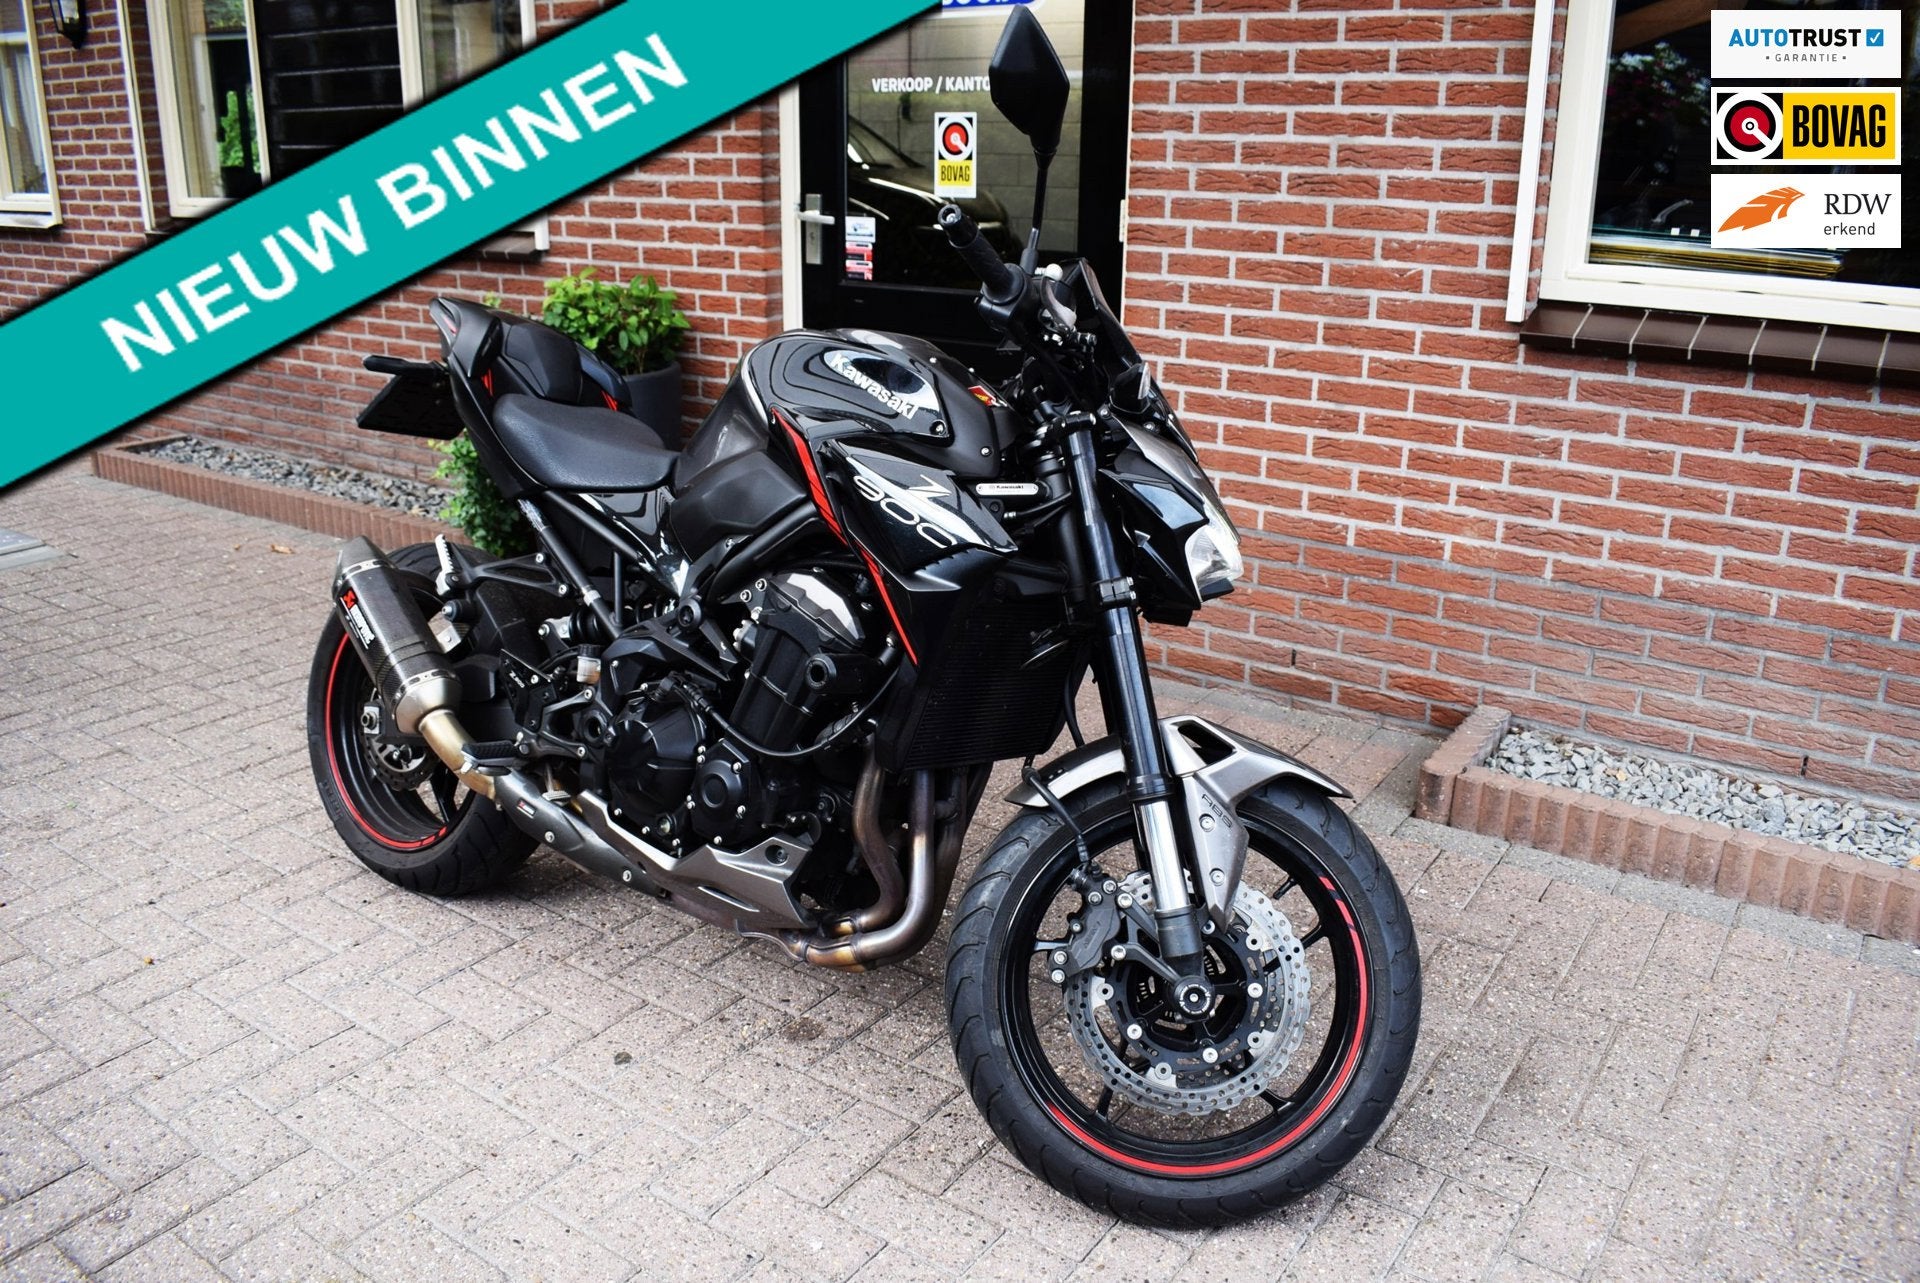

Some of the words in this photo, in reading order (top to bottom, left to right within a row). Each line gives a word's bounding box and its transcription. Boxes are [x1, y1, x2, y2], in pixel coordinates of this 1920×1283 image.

[872, 77, 933, 92] VERKOOP
[935, 76, 943, 94] /
[940, 164, 970, 182] BOVAG
[830, 352, 919, 421] Kawasaki
[853, 475, 958, 549] 900
[1201, 793, 1232, 828] ABS
